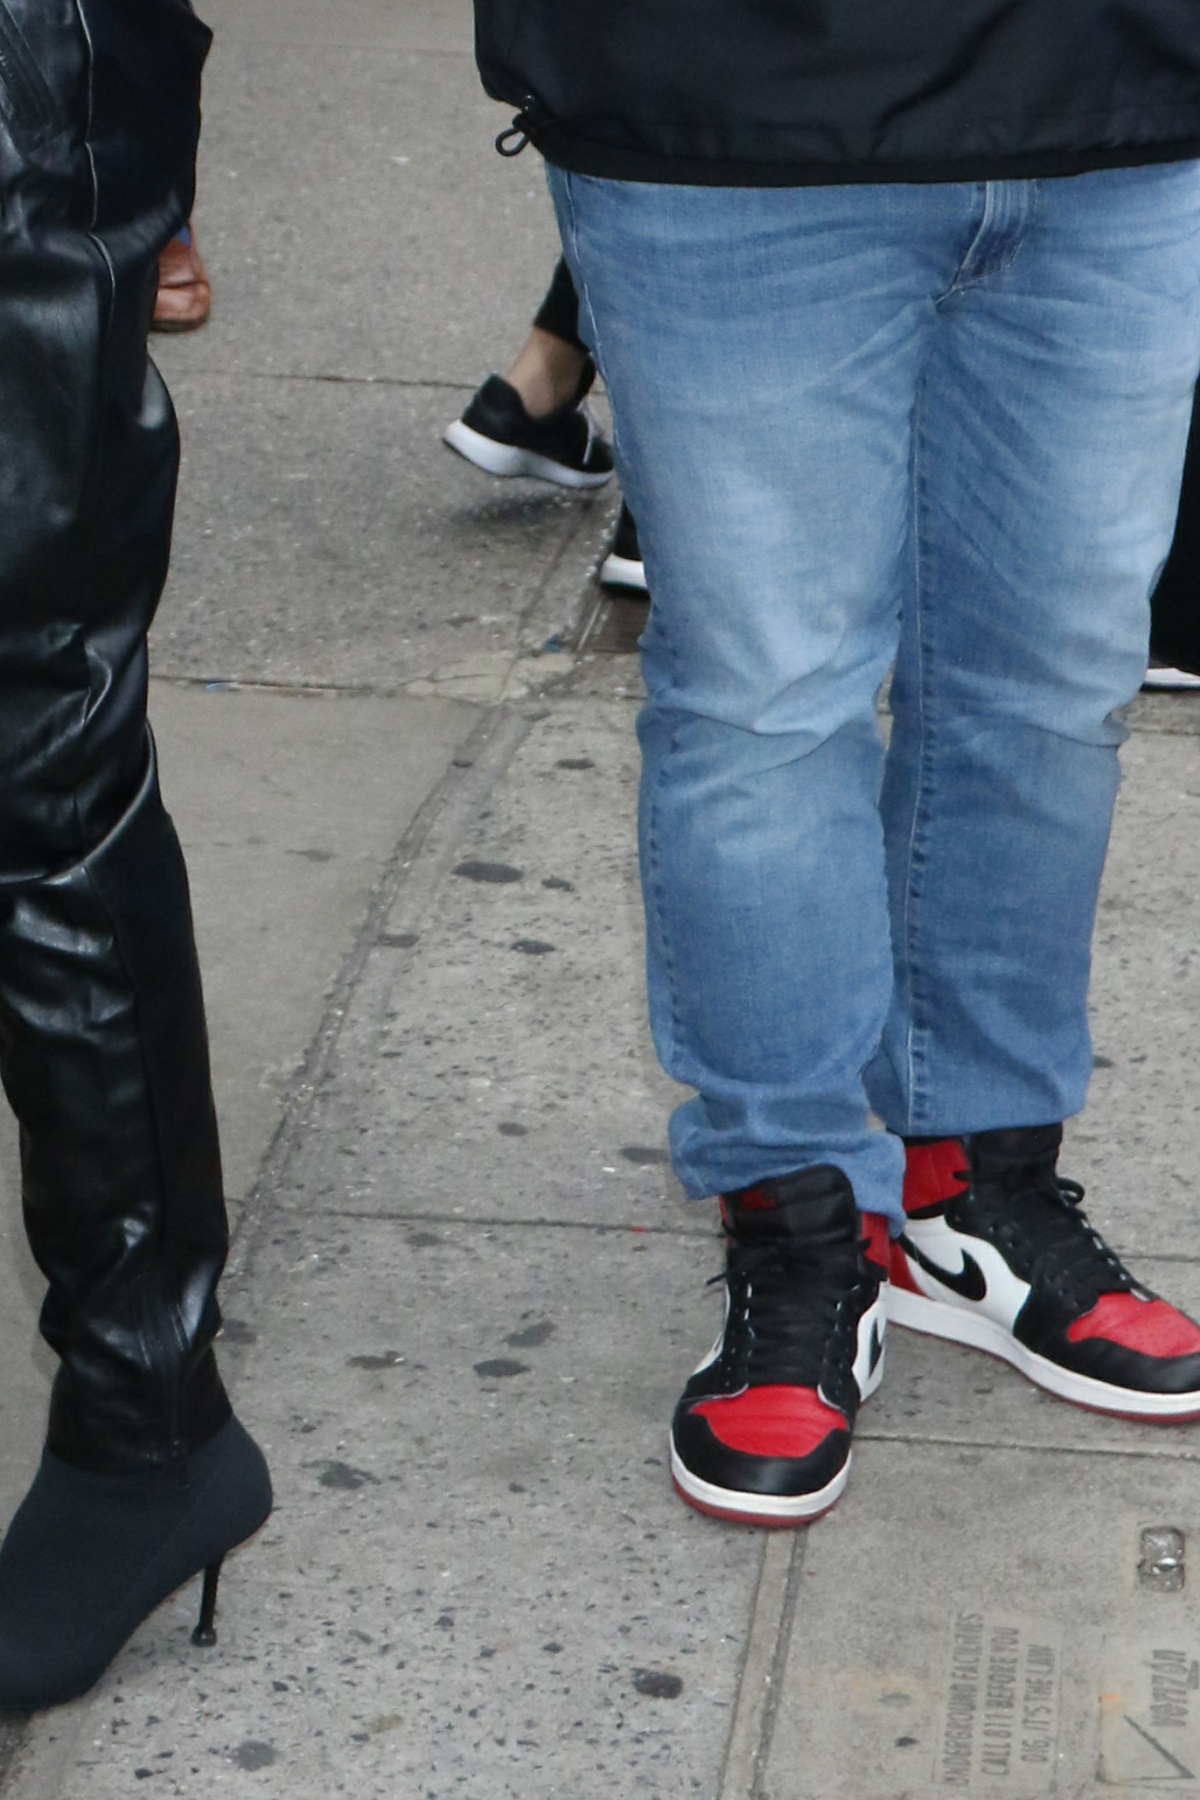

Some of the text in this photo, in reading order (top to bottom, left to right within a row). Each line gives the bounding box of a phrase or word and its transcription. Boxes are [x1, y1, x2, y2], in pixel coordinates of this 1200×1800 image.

[941, 1611, 985, 1787] UNDERGROUND FACILITIES
[980, 1626, 1020, 1776] CALL 811 BEFORE YOU
[1023, 1679, 1054, 1703] THE
[1026, 1643, 1055, 1675] LAW
